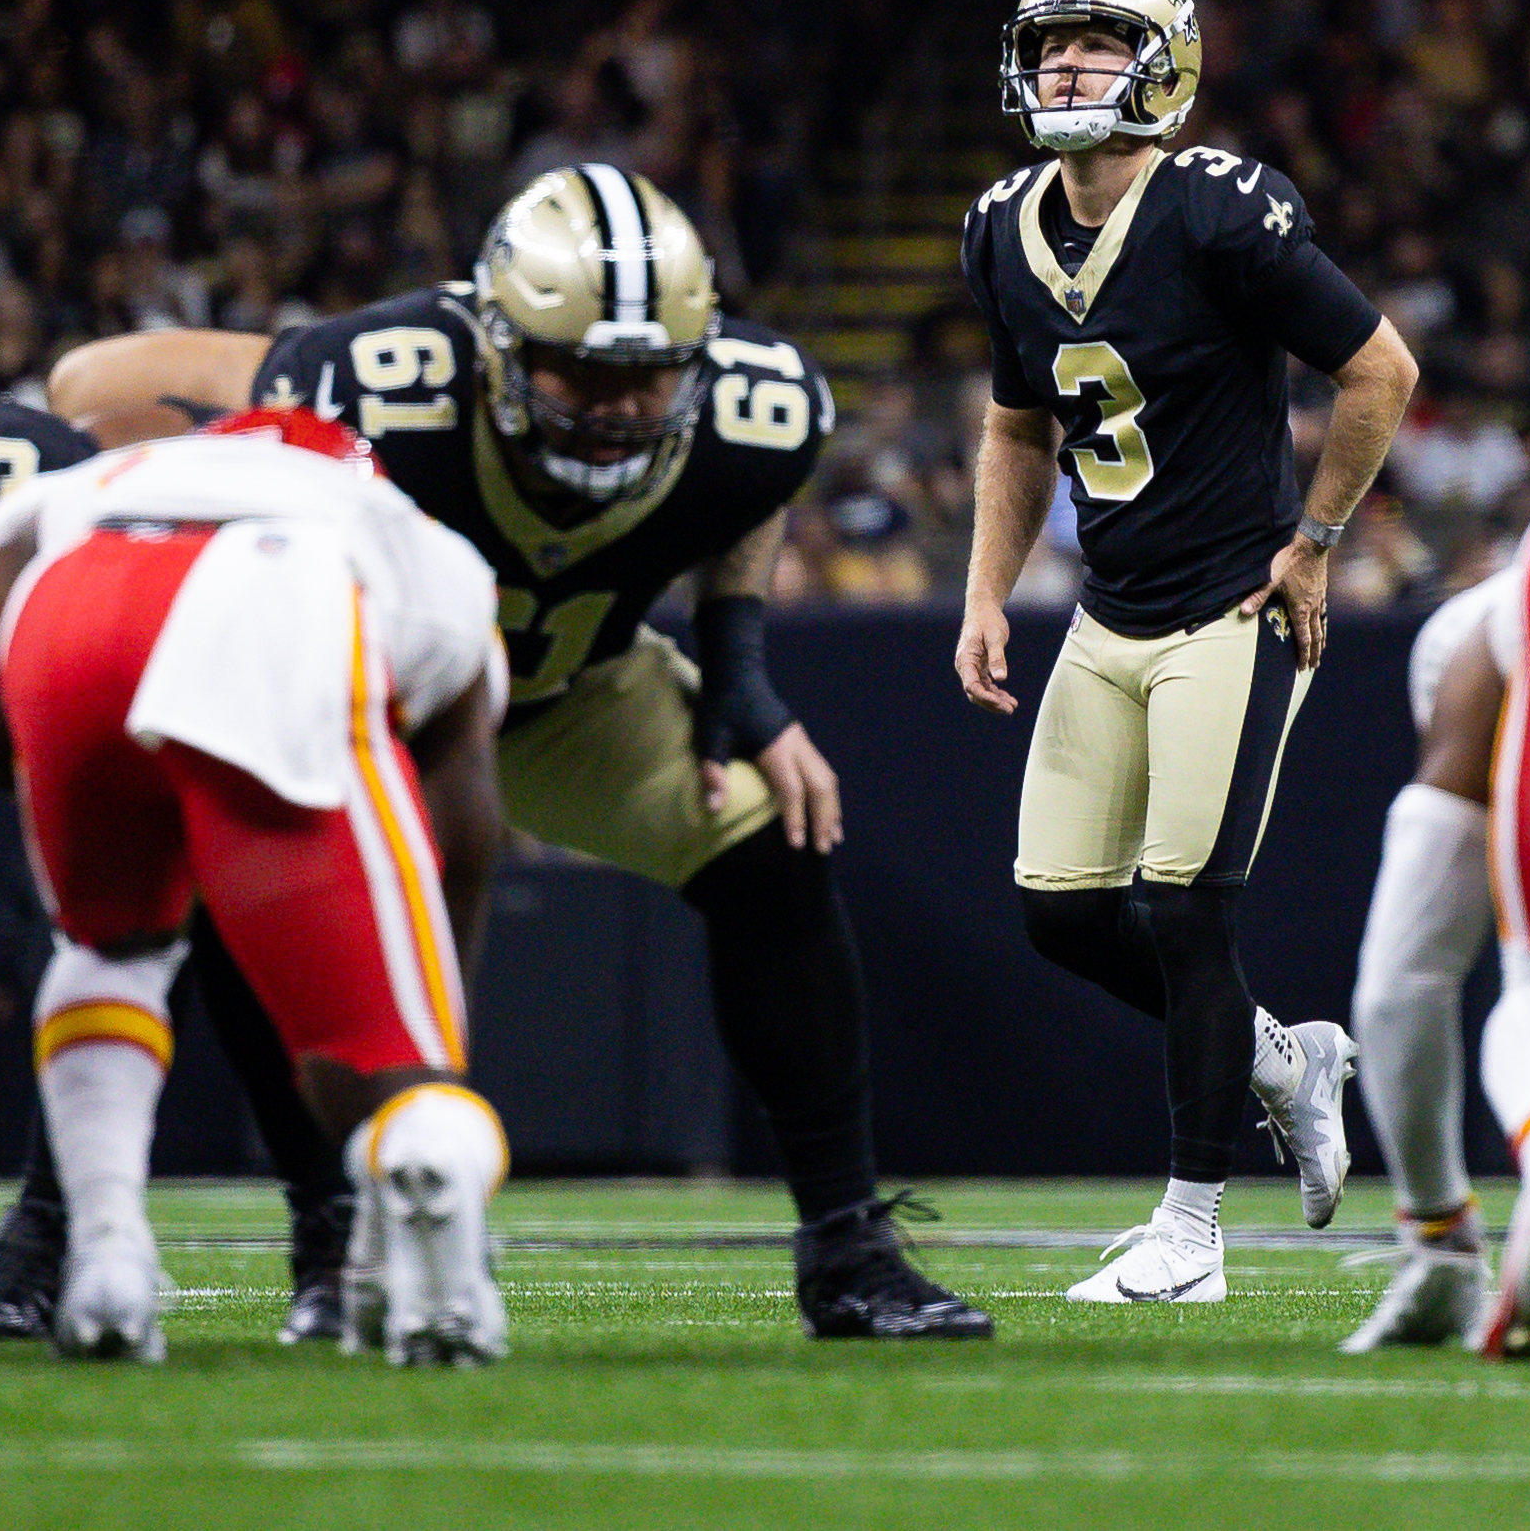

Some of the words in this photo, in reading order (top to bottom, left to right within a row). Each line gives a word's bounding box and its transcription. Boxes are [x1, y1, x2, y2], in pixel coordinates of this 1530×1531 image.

[1174, 146, 1243, 177] 3
[349, 326, 457, 440] 61
[707, 338, 811, 450] 61
[1052, 341, 1153, 501] 3
